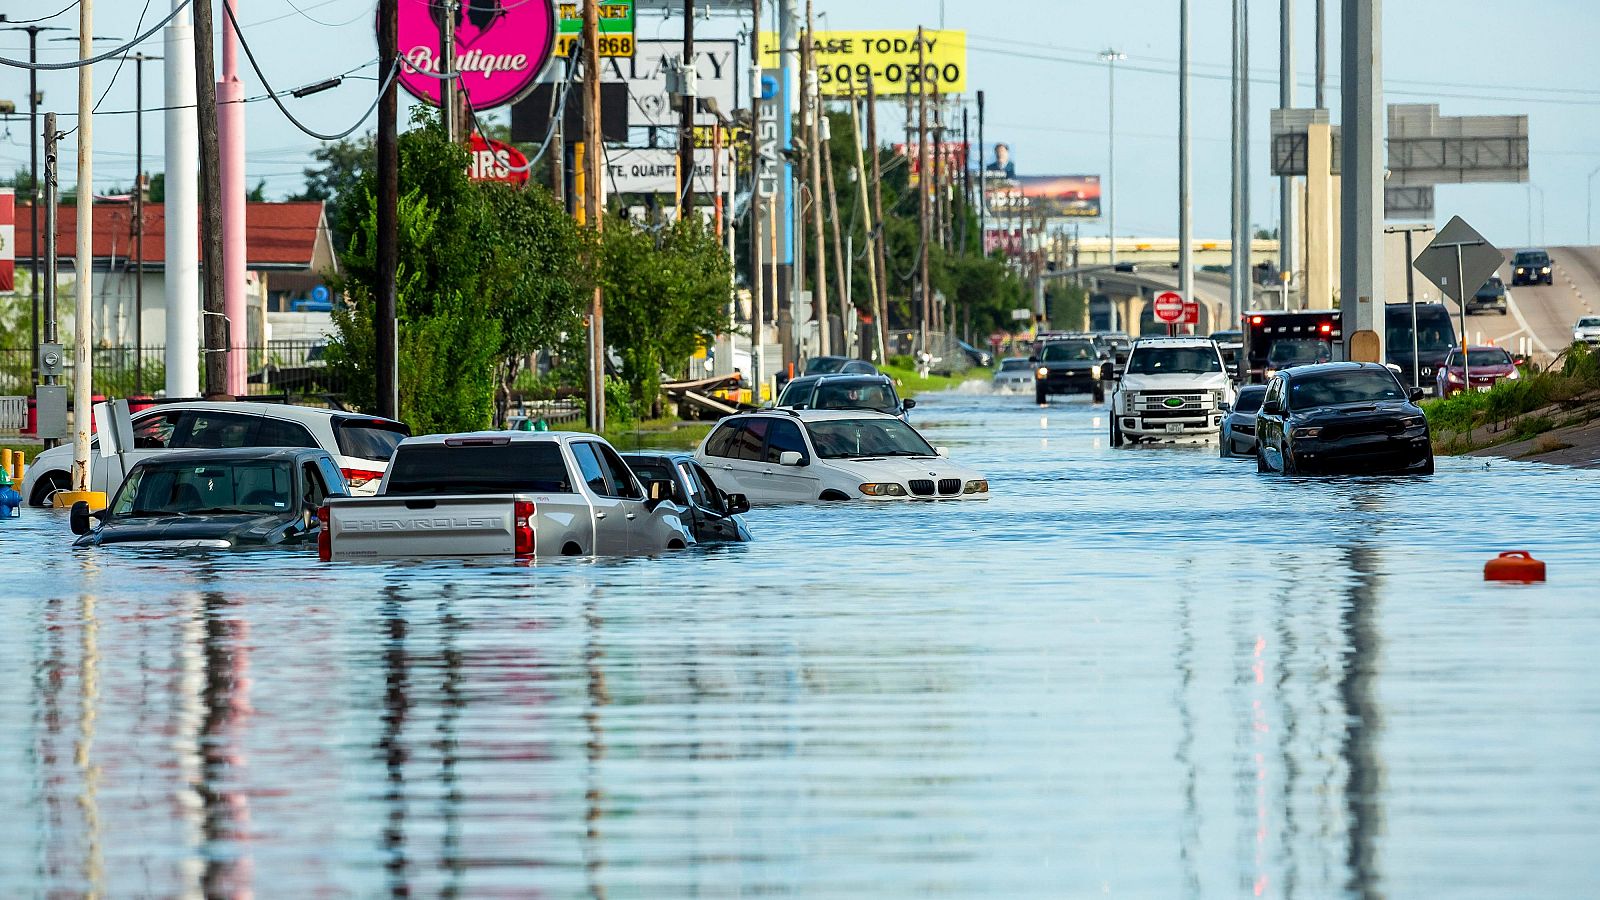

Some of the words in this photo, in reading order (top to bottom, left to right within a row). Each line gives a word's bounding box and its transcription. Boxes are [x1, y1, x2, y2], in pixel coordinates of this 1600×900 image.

[559, 4, 629, 19] PLNET
[814, 38, 853, 54] ASE
[862, 38, 937, 54] TODAY
[758, 104, 778, 198] CHASE
[341, 517, 501, 532] CHEVROLET
